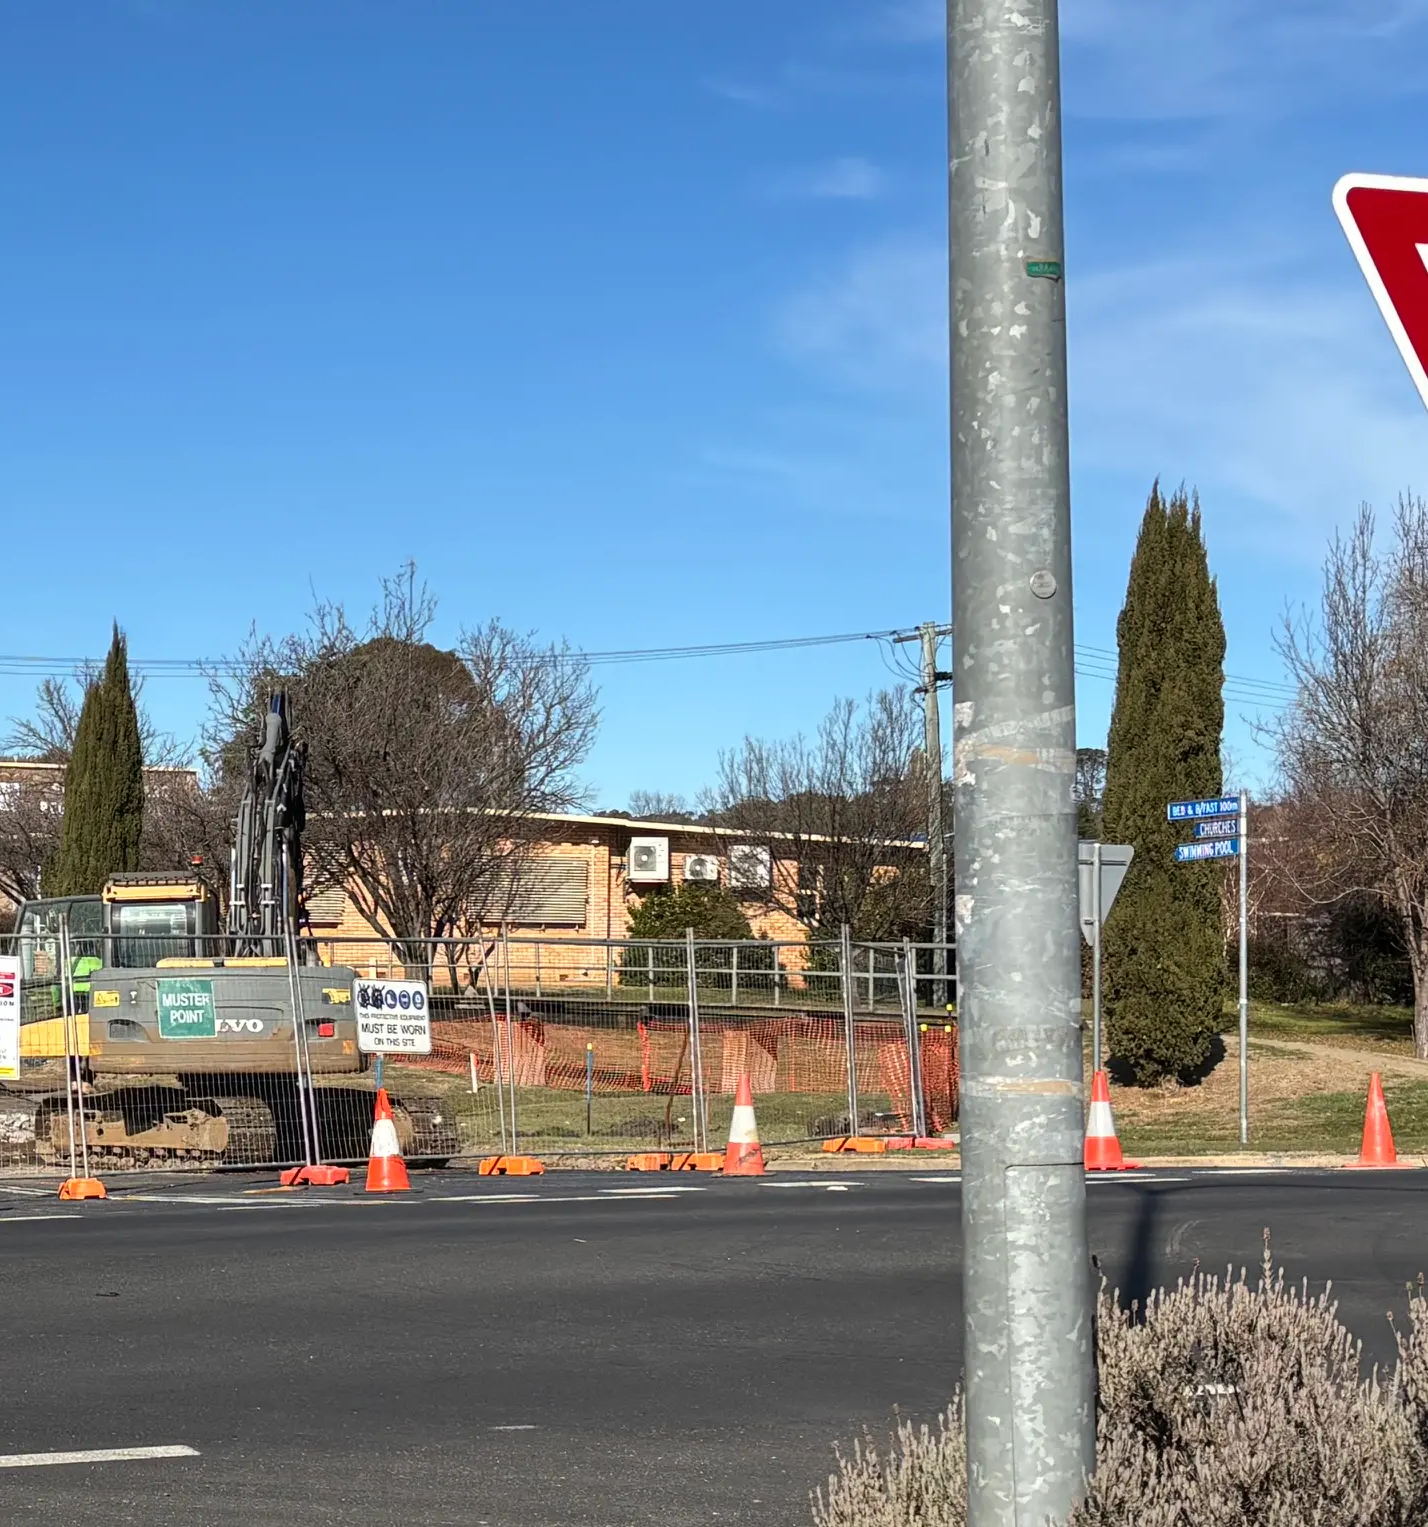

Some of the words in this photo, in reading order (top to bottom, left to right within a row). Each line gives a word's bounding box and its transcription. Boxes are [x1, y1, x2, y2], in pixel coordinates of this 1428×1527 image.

[1199, 820, 1236, 836] CHURCHES
[1178, 843, 1214, 860] SWIMMING
[1215, 840, 1234, 855] POOL
[162, 993, 212, 1007] MUSTER
[170, 1010, 205, 1023] POINT
[215, 1019, 264, 1033] LVO
[361, 1023, 384, 1034] MUST
[387, 1024, 398, 1034] BE
[400, 1024, 426, 1035] WORN
[374, 1037, 384, 1046] ON
[386, 1038, 400, 1046] THIS
[402, 1038, 416, 1047] SITE
